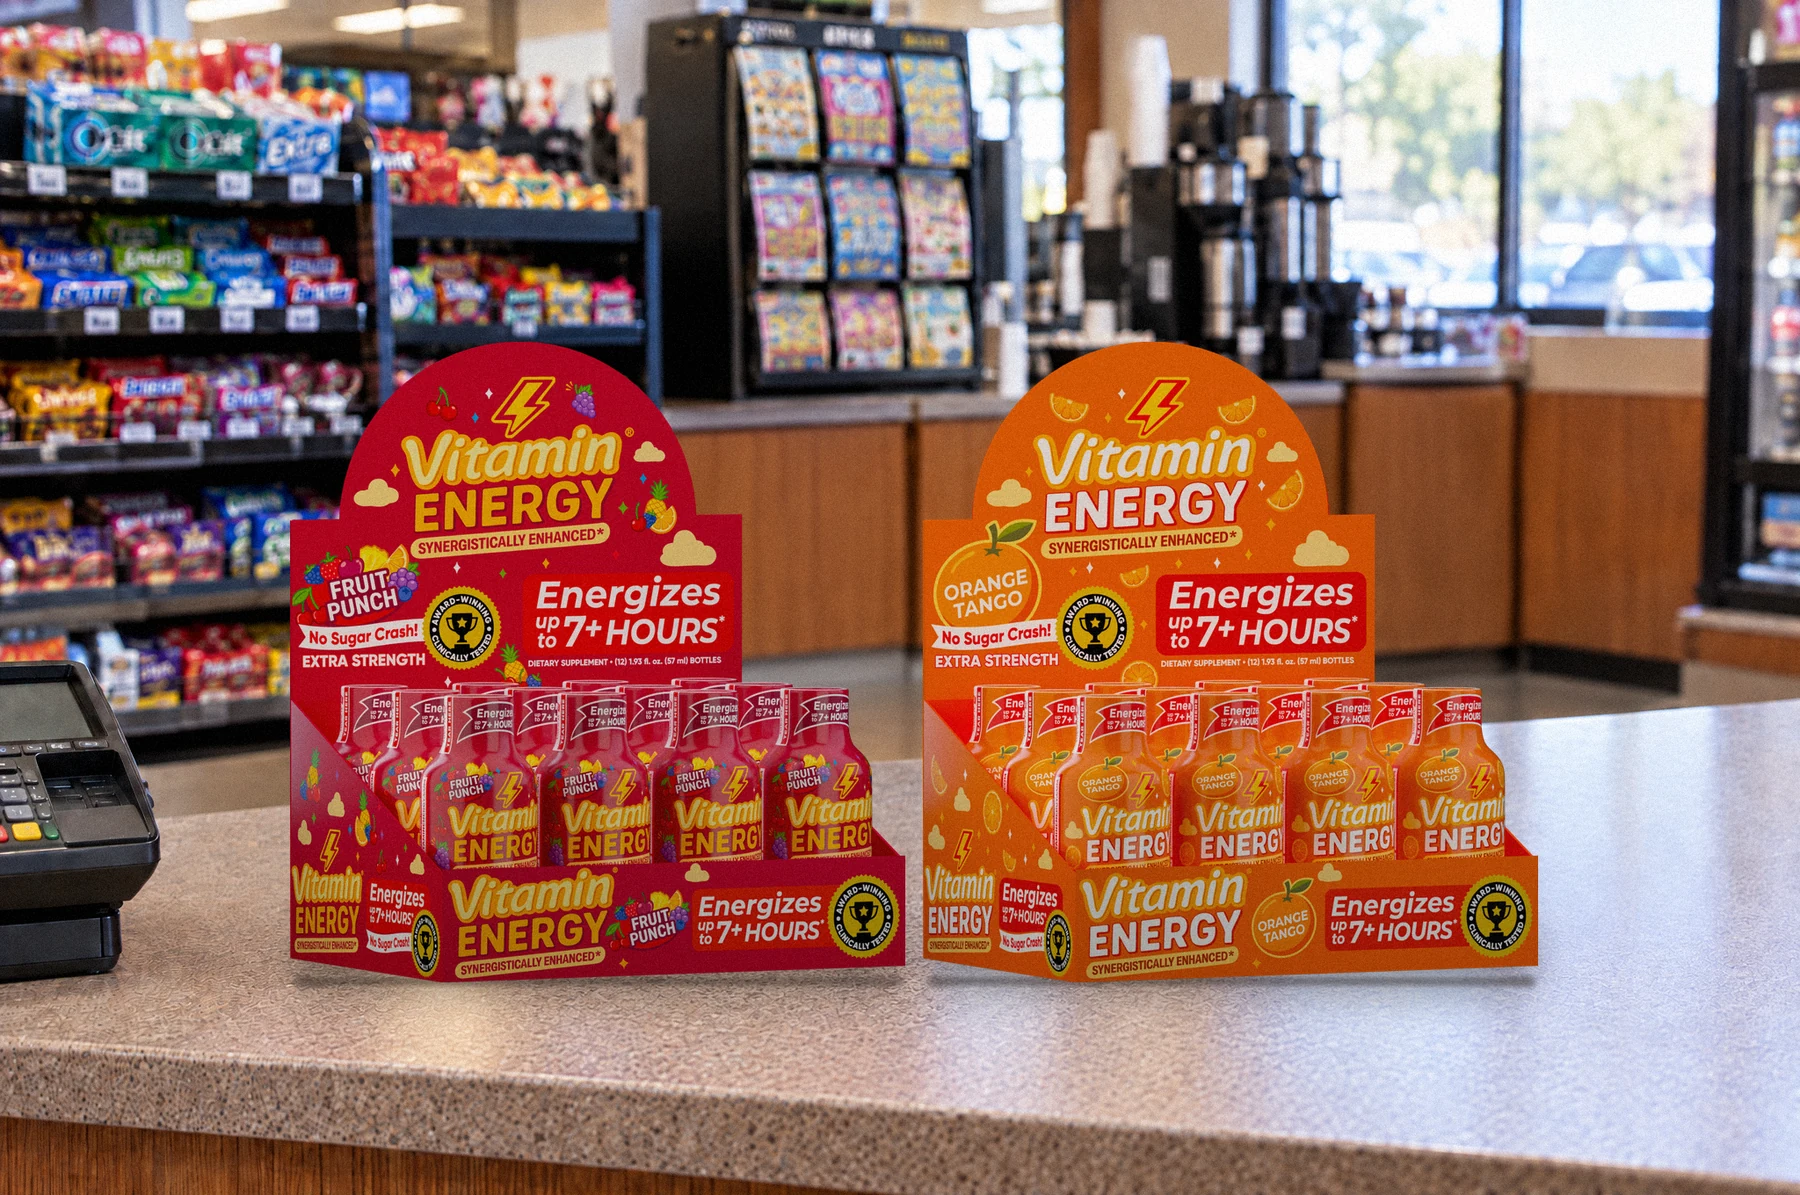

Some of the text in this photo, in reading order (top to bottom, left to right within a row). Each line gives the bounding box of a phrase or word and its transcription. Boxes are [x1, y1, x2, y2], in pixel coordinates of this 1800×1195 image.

[414, 478, 614, 532] ENERGY
[1045, 480, 1248, 532] ENERGY
[418, 534, 526, 554] SYNERGISTICALLY
[1048, 536, 1158, 554] SYNERGISTICALLY
[329, 570, 389, 600] FRUIT
[536, 575, 721, 614] Energizes
[944, 569, 1029, 601] ORANGE
[1169, 575, 1354, 615] Energizes
[327, 588, 398, 622] PUNCH
[432, 596, 492, 626] AWARD-WINNING
[953, 590, 1023, 619] TANGO
[1065, 596, 1125, 626] AWARD-WINNING
[309, 624, 419, 647] No Sugar Crash!
[535, 616, 560, 632] up
[563, 615, 602, 647] 7+
[537, 633, 557, 648] to
[942, 623, 1052, 647] No Sugar Crash!
[1168, 616, 1193, 632] up
[1196, 615, 1235, 647] 7+
[1170, 633, 1190, 648] to
[431, 633, 492, 662] CLINICALLY TESTED
[1064, 633, 1126, 662] CLINICALLY TESTED
[302, 653, 426, 668] EXTRA STRENGTH
[528, 659, 559, 667] DIETARY
[560, 658, 608, 666] SUPPLEMENT
[614, 658, 628, 666] (12)
[628, 657, 642, 665] 1.93
[664, 657, 675, 665] (57
[690, 656, 722, 664] BOTTLES
[935, 653, 1059, 668] EXTRA STRENGTH
[1161, 659, 1191, 667] DIETARY
[1193, 658, 1241, 666] SUPPLEMENT
[1247, 658, 1260, 666] (12)
[1261, 657, 1275, 665] 1.93
[1297, 657, 1308, 665] (57
[1322, 656, 1354, 664] BOTTLES
[450, 775, 479, 790] FRUIT
[564, 772, 593, 787] FRUIT
[676, 769, 706, 784] FRUIT
[786, 775, 822, 791] PUNCH
[788, 766, 816, 780] FRUIT
[1082, 775, 1122, 787] ORANGE
[1196, 772, 1236, 784] ORANGE
[1309, 769, 1348, 781] ORANGE
[1313, 778, 1347, 788] TANGO
[1420, 766, 1460, 778] ORANGE
[1424, 774, 1457, 785] TANGO
[448, 785, 484, 801] PUNCH
[562, 781, 598, 797] PUNCH
[675, 779, 711, 795] PUNCH
[1086, 783, 1121, 794] TANGO
[1200, 780, 1234, 791] TANGO
[369, 883, 425, 909] Energizes
[698, 891, 822, 920] Energizes
[837, 884, 892, 915] AWARD-WINNING
[1002, 882, 1058, 909] Energizes
[1331, 891, 1455, 920] Energizes
[1469, 884, 1524, 915] AWARD-WINNING
[295, 905, 359, 935] ENERGY
[631, 908, 670, 930] FRUIT
[928, 905, 993, 935] ENERGY
[1258, 909, 1308, 932] ORANGE
[369, 935, 410, 951] No Sugar Crash!
[458, 910, 608, 957] ENERGY
[629, 921, 676, 947] PUNCH
[698, 921, 714, 934] up
[717, 920, 743, 944] 7+
[699, 933, 713, 945] to
[835, 921, 892, 950] CLINICALLY TESTED
[1002, 935, 1043, 951] No Sugar Crash!
[1089, 909, 1241, 957] ENERGY
[1263, 924, 1306, 944] TANGO
[1330, 920, 1347, 933] up
[1350, 920, 1376, 944] 7+
[1331, 932, 1345, 945] to
[1469, 921, 1524, 950] CLINICALLY TESTED
[461, 957, 542, 975] SYNERGISTICALLY
[1092, 957, 1174, 975] SYNERGISTICALLY
